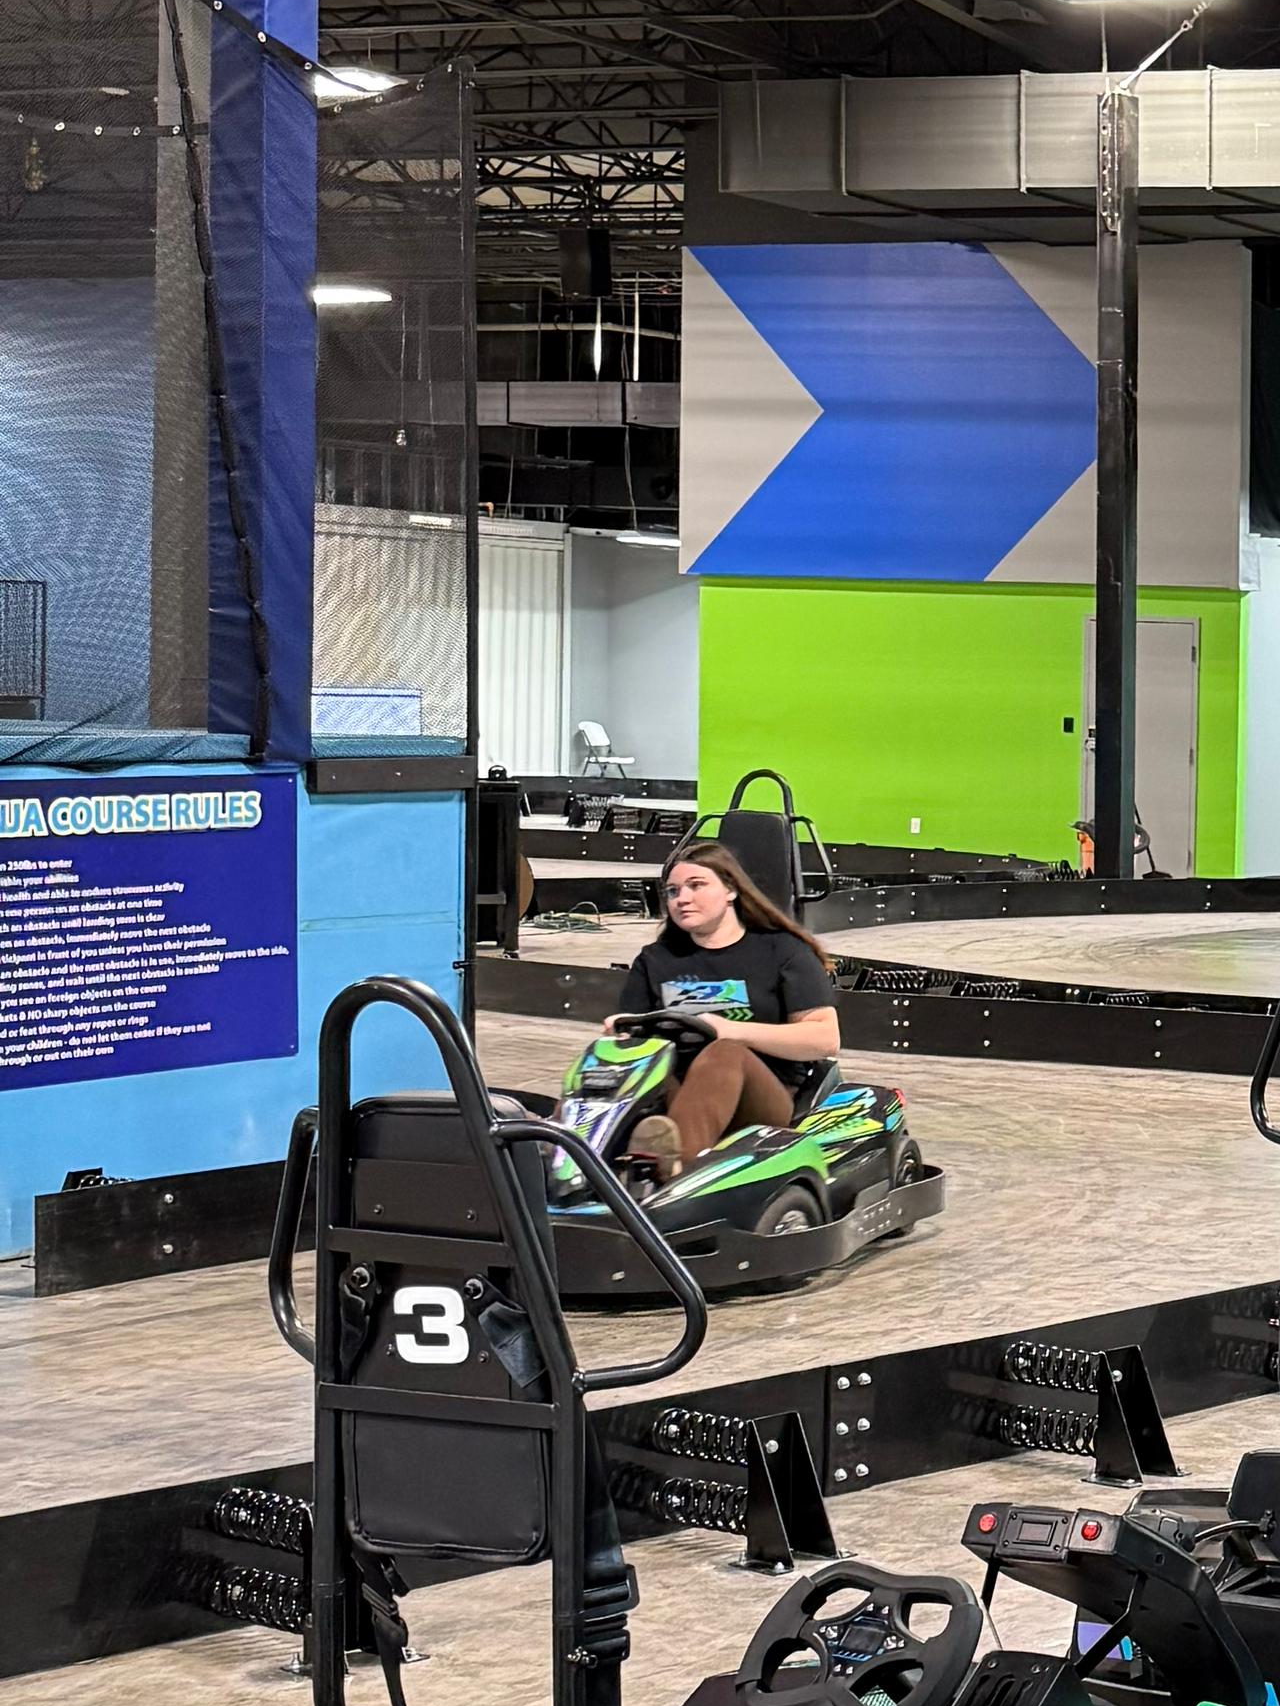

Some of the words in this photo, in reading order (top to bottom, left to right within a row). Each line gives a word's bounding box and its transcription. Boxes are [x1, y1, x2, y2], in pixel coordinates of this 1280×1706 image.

[48, 794, 170, 836] COURSE
[171, 791, 262, 830] RULES
[37, 861, 48, 869] to
[48, 860, 72, 868] enter
[22, 877, 43, 888] your
[44, 874, 79, 884] abilities
[2, 892, 31, 901] health
[32, 890, 50, 900] and
[50, 889, 69, 898] able
[70, 889, 80, 897] to
[154, 882, 184, 892] activity
[80, 901, 116, 912] obstacle
[116, 901, 126, 909] at
[143, 898, 162, 907] time
[23, 920, 60, 931] obstacle
[61, 918, 81, 928] until
[82, 916, 115, 927] landing
[136, 914, 144, 922] is
[145, 913, 165, 922] clear
[66, 931, 119, 942] immediately
[143, 928, 157, 937] the
[158, 927, 177, 936] next
[177, 923, 211, 934] obstacle
[36, 951, 46, 960] in
[46, 950, 69, 959] front
[70, 948, 80, 958] of
[81, 949, 97, 959] you
[98, 945, 125, 955] unless
[125, 945, 142, 955] you
[142, 943, 162, 951] have
[163, 940, 183, 950] their
[183, 938, 226, 950] permission
[12, 966, 50, 978] obstacle
[50, 964, 68, 974] and
[68, 964, 84, 973] the
[84, 963, 104, 971] next
[105, 959, 139, 969] obstacle
[140, 958, 148, 966] is
[148, 957, 157, 966] in
[175, 951, 224, 963] immediately
[224, 951, 246, 959] move
[256, 948, 270, 956] the
[47, 977, 64, 988] and
[65, 976, 84, 986] wait
[85, 974, 105, 984] until
[106, 973, 120, 982] the
[121, 972, 140, 980] next
[141, 968, 175, 979] obstacle
[176, 967, 183, 975] is
[0, 999, 18, 1009] you
[18, 998, 34, 1006] see
[47, 992, 79, 1003] foreign
[80, 989, 111, 1000] objects
[124, 986, 139, 995] the
[139, 985, 166, 994] course
[27, 1010, 42, 1020] NO
[42, 1009, 68, 1018] sharp
[68, 1006, 100, 1017] objects
[113, 1002, 128, 1011] the
[128, 1001, 156, 1009] course
[38, 1022, 74, 1034] through
[74, 1022, 91, 1031] any
[92, 1020, 116, 1030] ropes
[127, 1016, 149, 1026] rings
[4, 1044, 25, 1055] your
[26, 1039, 63, 1050] children
[68, 1037, 80, 1045] do
[81, 1035, 96, 1044] not
[97, 1033, 109, 1043] let
[110, 1032, 132, 1041] them
[133, 1030, 155, 1038] enter
[156, 1027, 163, 1036] if
[163, 1026, 182, 1035] they
[182, 1025, 196, 1033] are
[196, 1022, 211, 1031] not
[43, 1052, 59, 1061] out
[72, 1047, 94, 1057] their
[94, 1047, 114, 1055] own
[394, 1287, 469, 1363] 3
